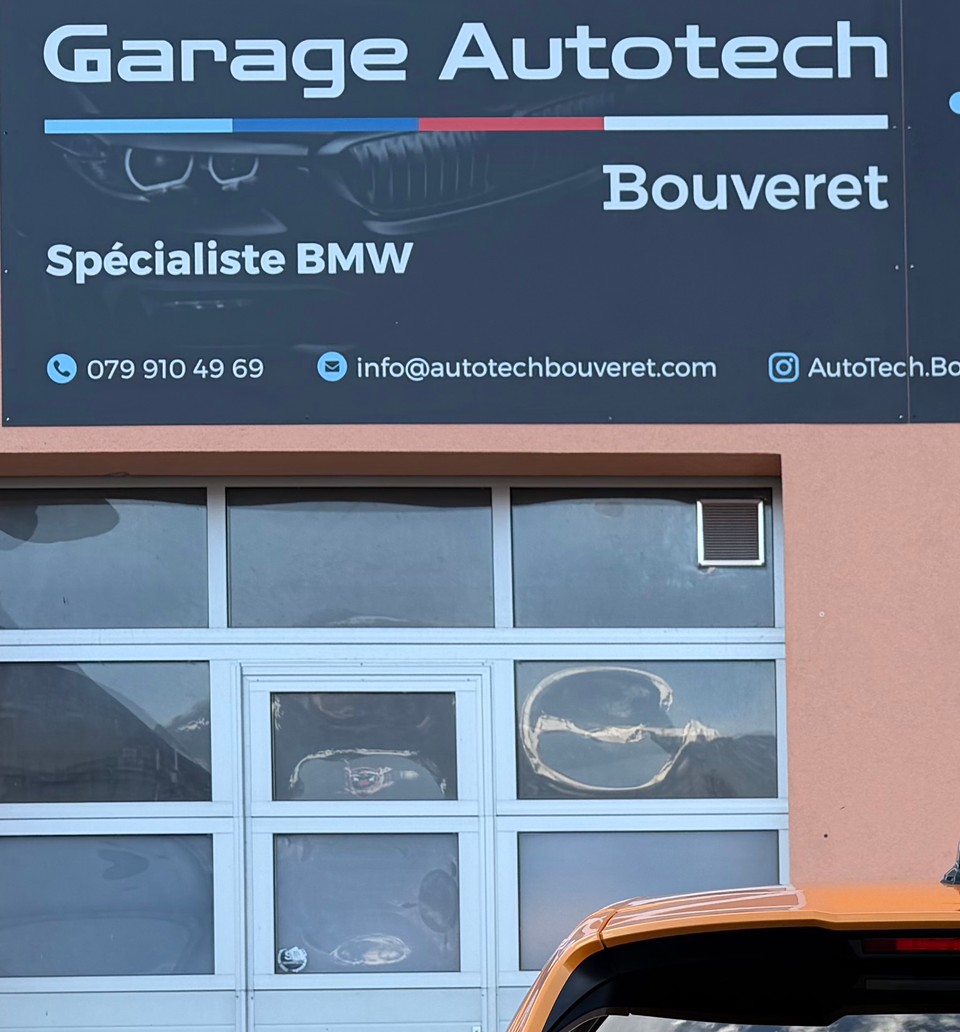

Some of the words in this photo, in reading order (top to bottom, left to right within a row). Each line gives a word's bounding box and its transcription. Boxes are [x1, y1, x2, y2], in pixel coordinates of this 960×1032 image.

[43, 24, 408, 99] Garage
[438, 20, 888, 81] Autotech
[602, 164, 889, 211] Bouveret
[45, 239, 286, 284] Spécialiste
[297, 242, 414, 275] BMW
[87, 359, 135, 380] 079
[143, 359, 186, 379] 910
[192, 358, 225, 379] 49
[232, 358, 264, 379] 69
[357, 356, 717, 382] info@autotechbouveret.com
